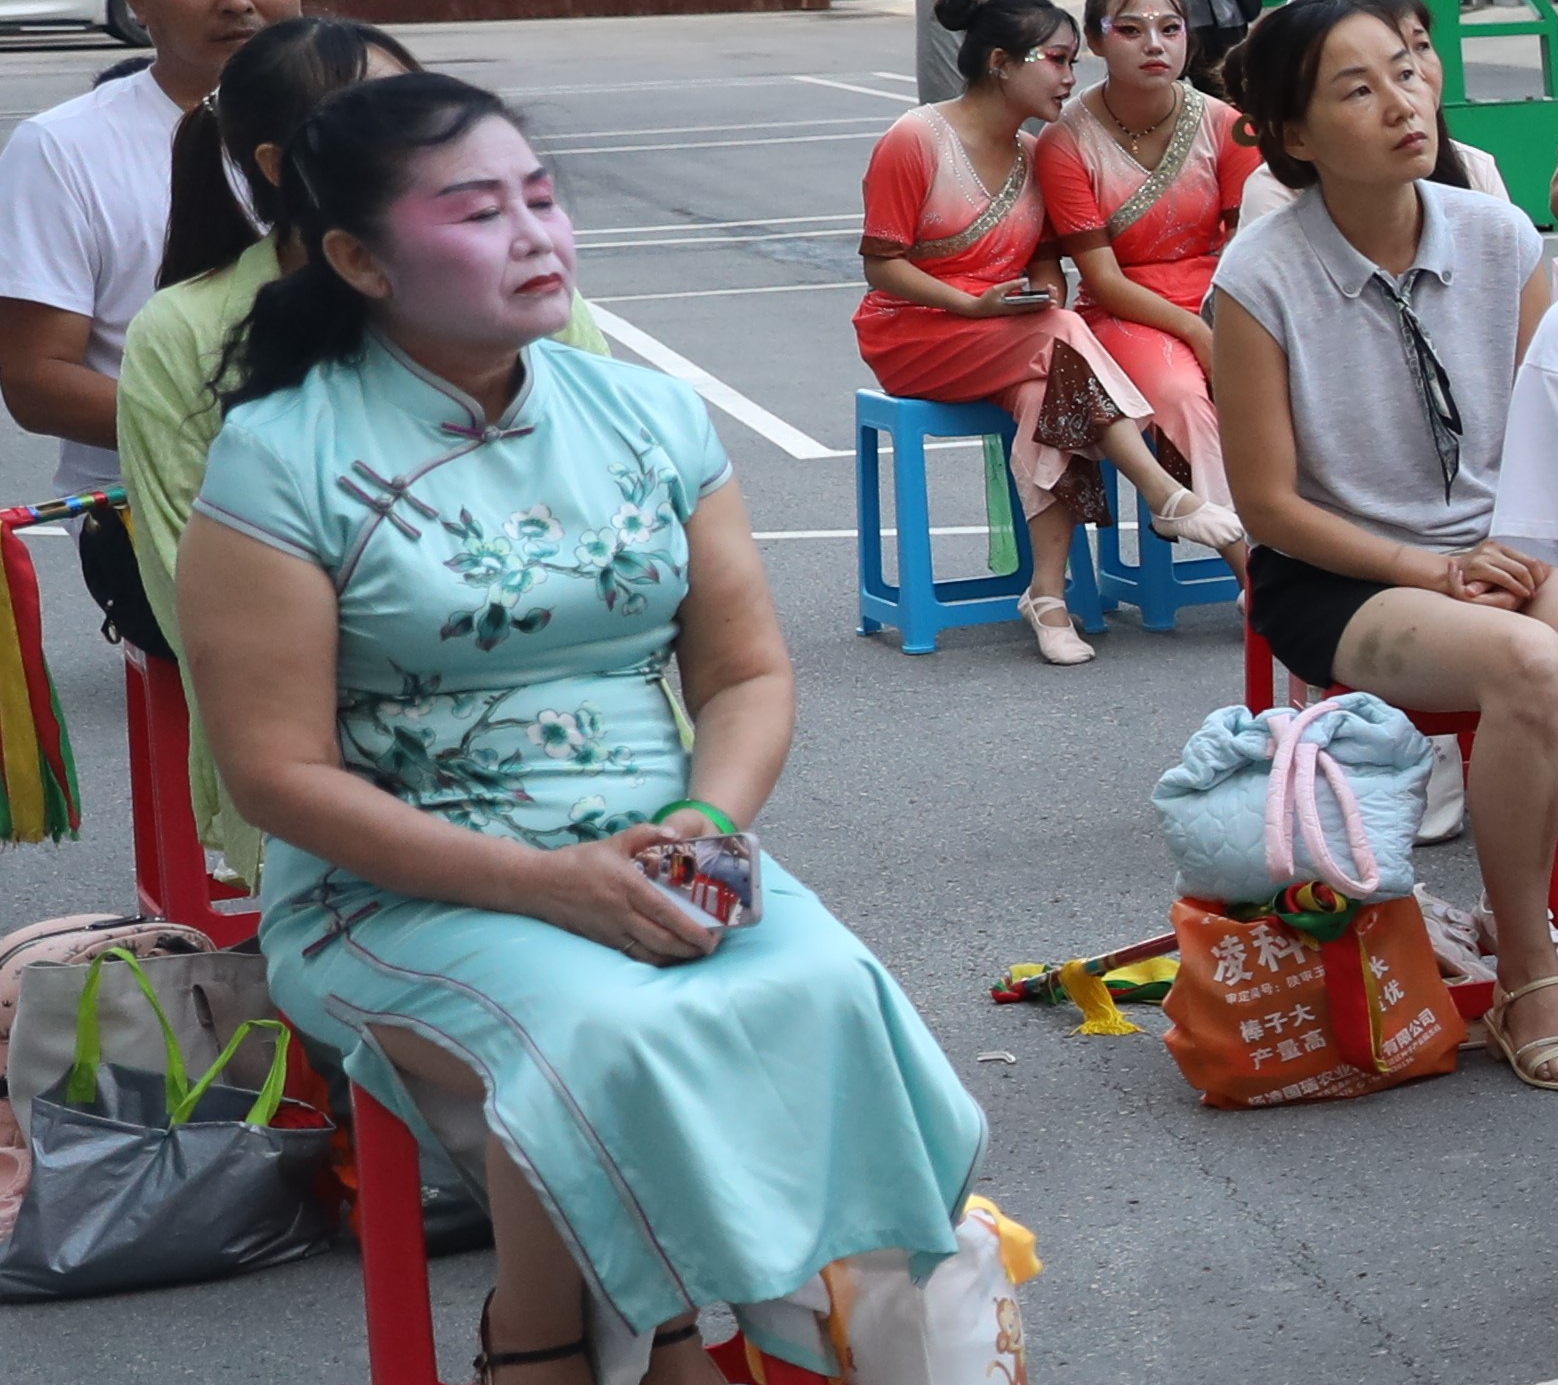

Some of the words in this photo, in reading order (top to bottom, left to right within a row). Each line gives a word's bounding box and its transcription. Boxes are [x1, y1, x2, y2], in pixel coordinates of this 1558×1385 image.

[1210, 923, 1307, 986] 凌科
[1239, 1002, 1316, 1044] 棒子大
[1248, 1028, 1327, 1071] 产量高
